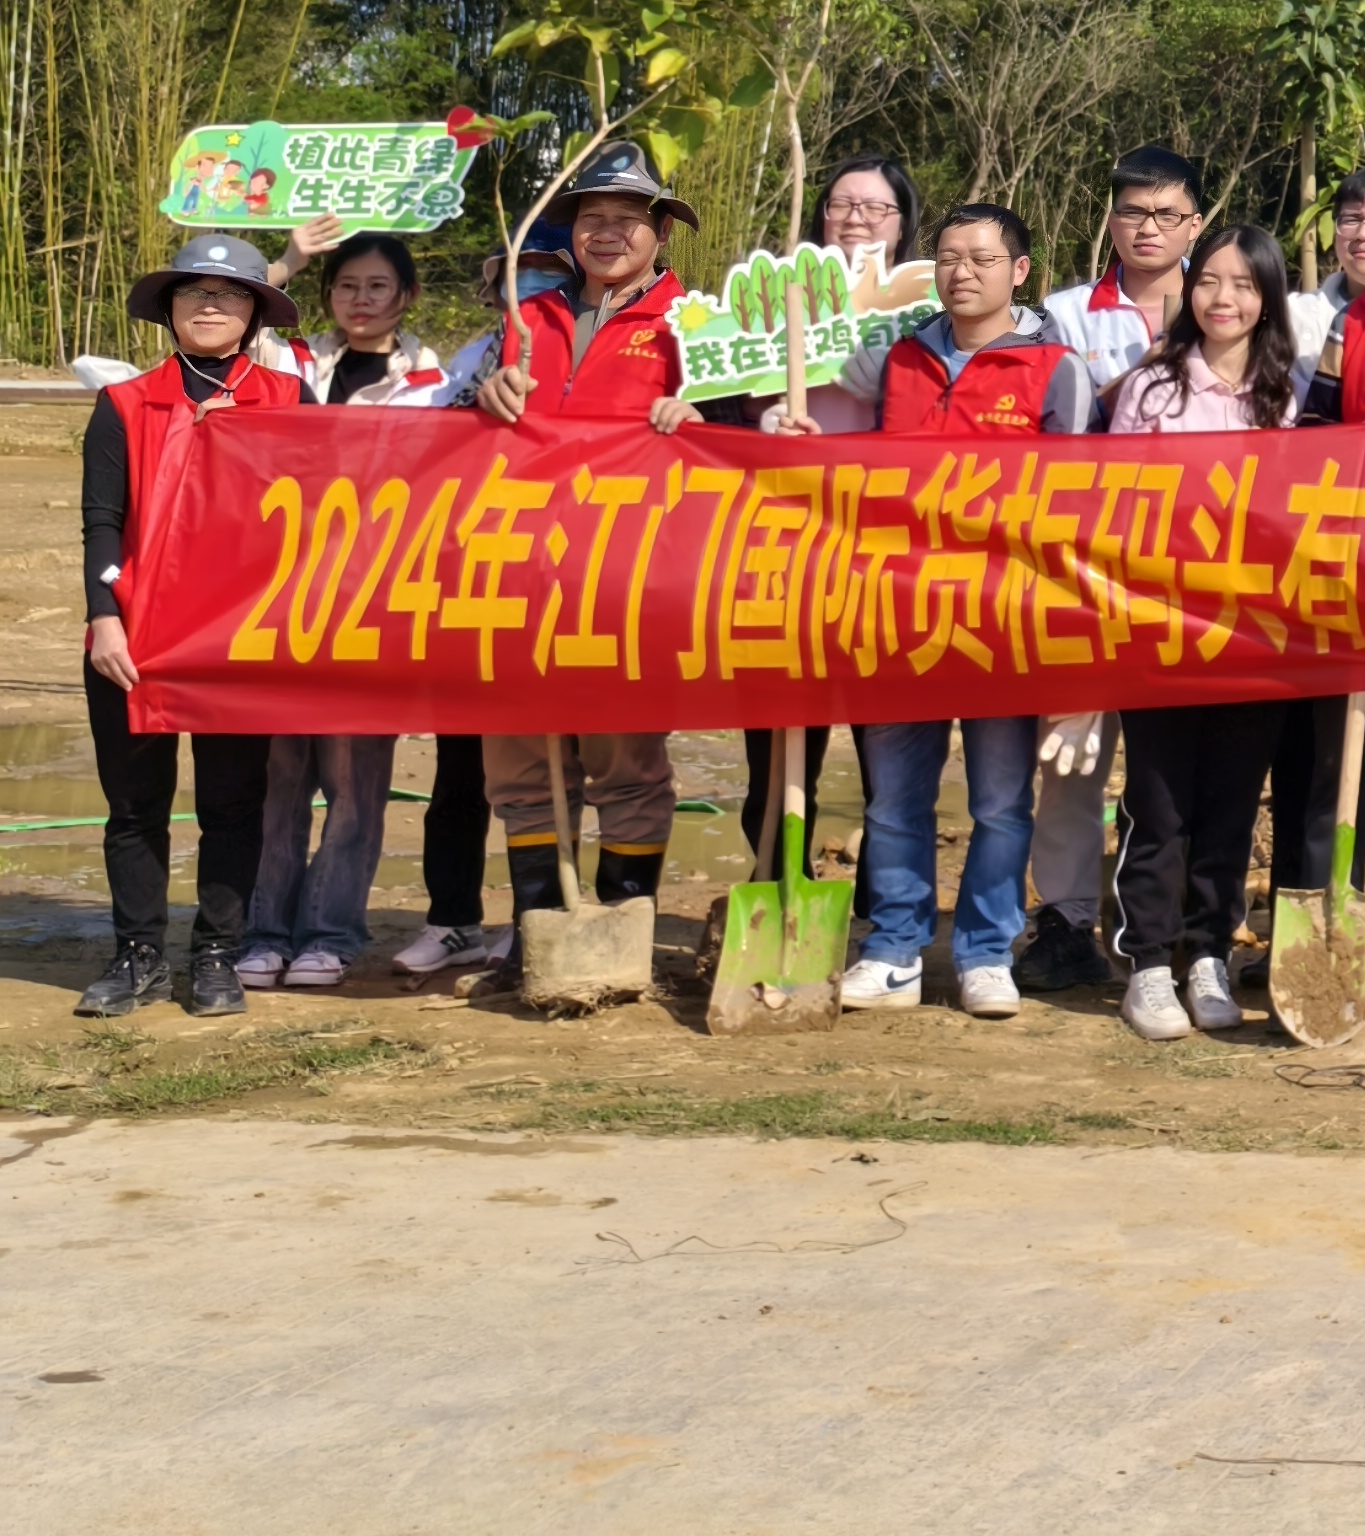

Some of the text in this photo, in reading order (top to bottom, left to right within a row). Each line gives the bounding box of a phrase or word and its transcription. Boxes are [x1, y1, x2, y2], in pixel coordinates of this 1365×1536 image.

[286, 134, 456, 174] 植此青绿
[292, 177, 462, 218] 生生不息
